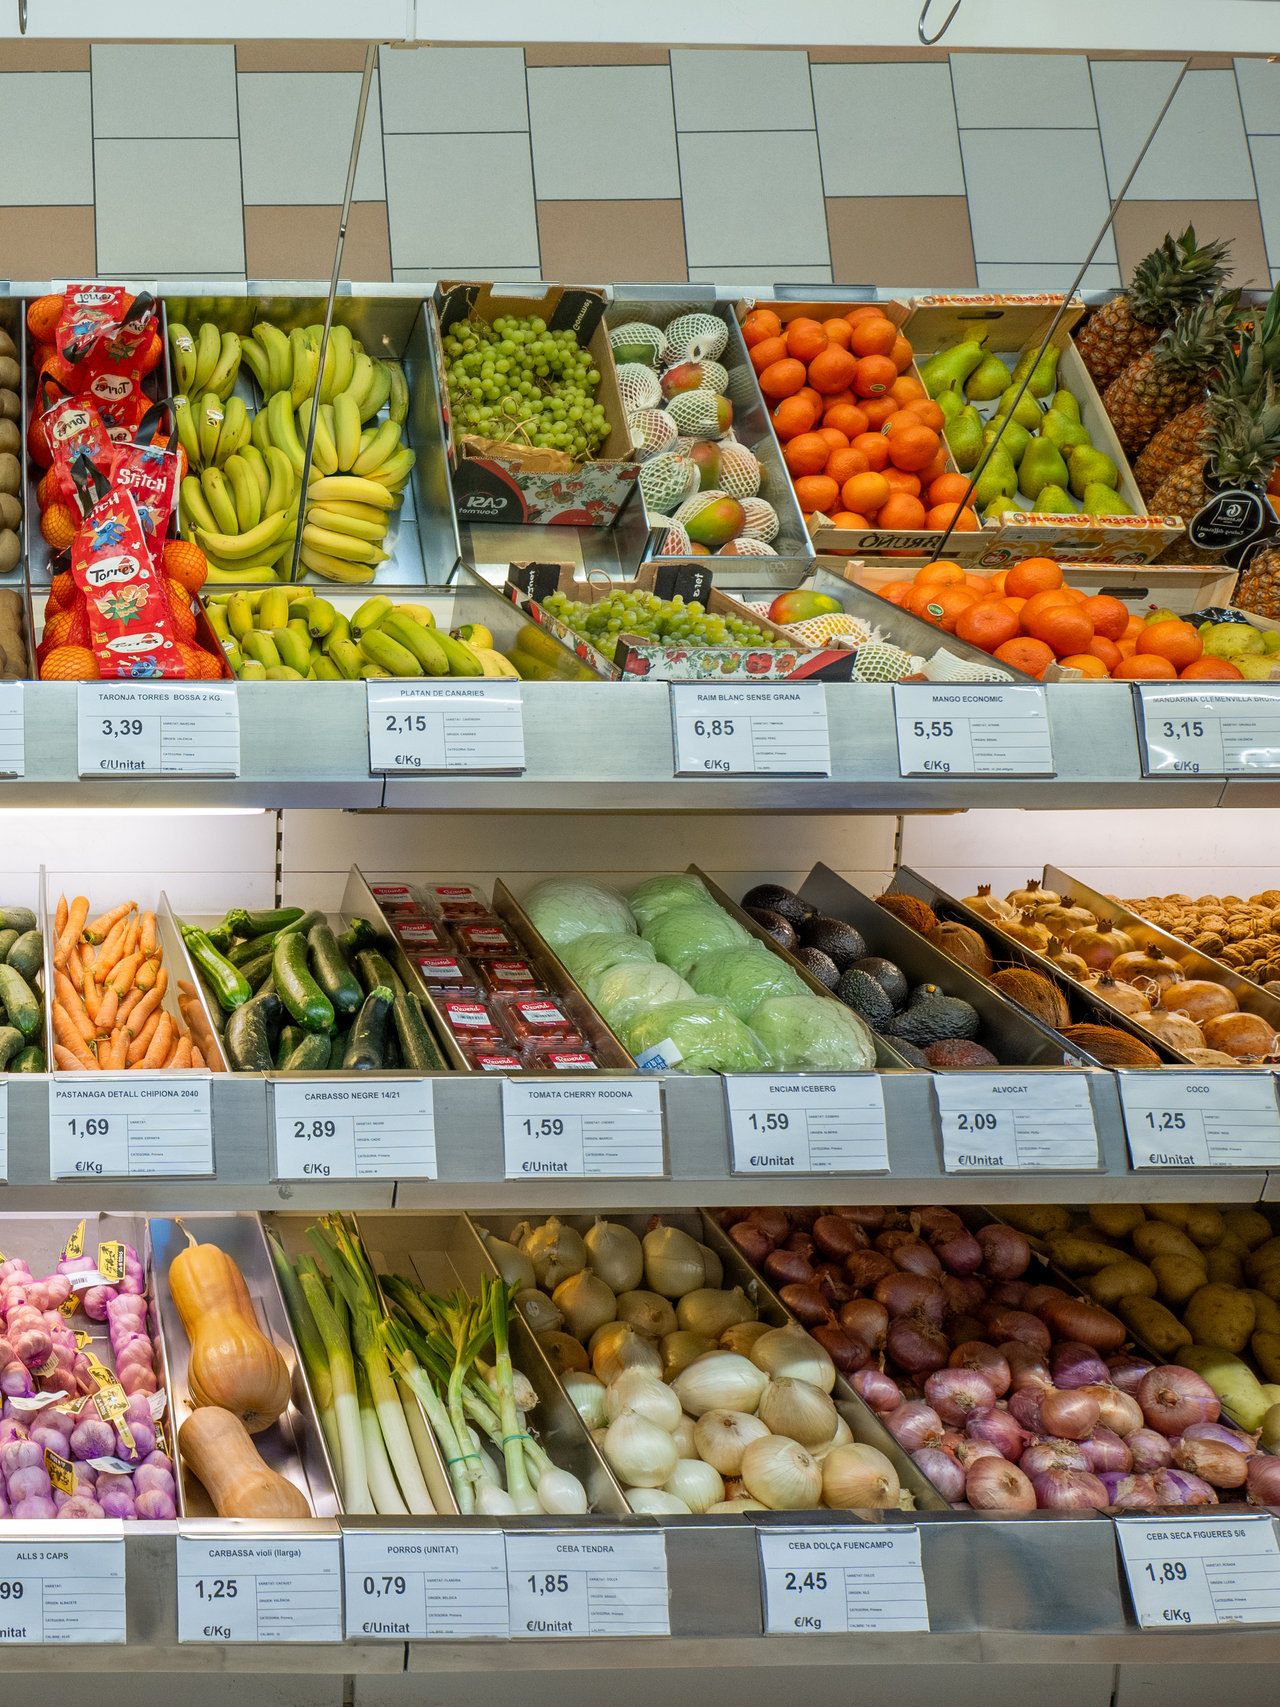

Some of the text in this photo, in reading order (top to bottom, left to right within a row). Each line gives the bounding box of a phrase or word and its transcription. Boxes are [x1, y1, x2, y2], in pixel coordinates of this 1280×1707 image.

[89, 564, 135, 583] Torres
[102, 720, 143, 738] 3,39
[386, 716, 426, 734] 2,15
[695, 720, 734, 738] 6,85
[914, 722, 953, 739] 5,55
[1163, 722, 1204, 740] 3,15
[100, 760, 145, 769] €/Unitat
[395, 755, 421, 766] €/Kg
[704, 760, 730, 771] €/Kg
[924, 761, 950, 772] €/Kg
[1174, 761, 1199, 772] €/Kg
[749, 1113, 789, 1133] 1,59
[958, 1114, 996, 1133] 2,09
[1146, 1112, 1186, 1131] 1,25
[68, 1119, 109, 1138] 1,69
[294, 1121, 335, 1140] 2,89
[523, 1119, 563, 1138] 1,59
[750, 1156, 794, 1166] €/Unitat
[958, 1156, 1003, 1165] €/Unitat
[1149, 1154, 1195, 1164] €/Unitat
[76, 1162, 102, 1173] €/Kg
[303, 1164, 330, 1176] €/Kg
[522, 1162, 568, 1172] €/Unitat
[1194, 1530, 1232, 1538] FIGUERES
[424, 1546, 458, 1554] (UNITAT)
[814, 1542, 841, 1550] DOLÇA
[1145, 1562, 1187, 1584] 1,89
[364, 1577, 406, 1597] 0,79
[528, 1575, 568, 1596] 1,85
[785, 1572, 827, 1593] 2,45
[195, 1580, 238, 1601] 1,25
[1163, 1609, 1191, 1622] €/Kg
[362, 1622, 410, 1633] €/Unitat
[527, 1621, 572, 1632] €/Unitat
[794, 1617, 821, 1629] €/Kg
[203, 1626, 231, 1638] €/Kg
